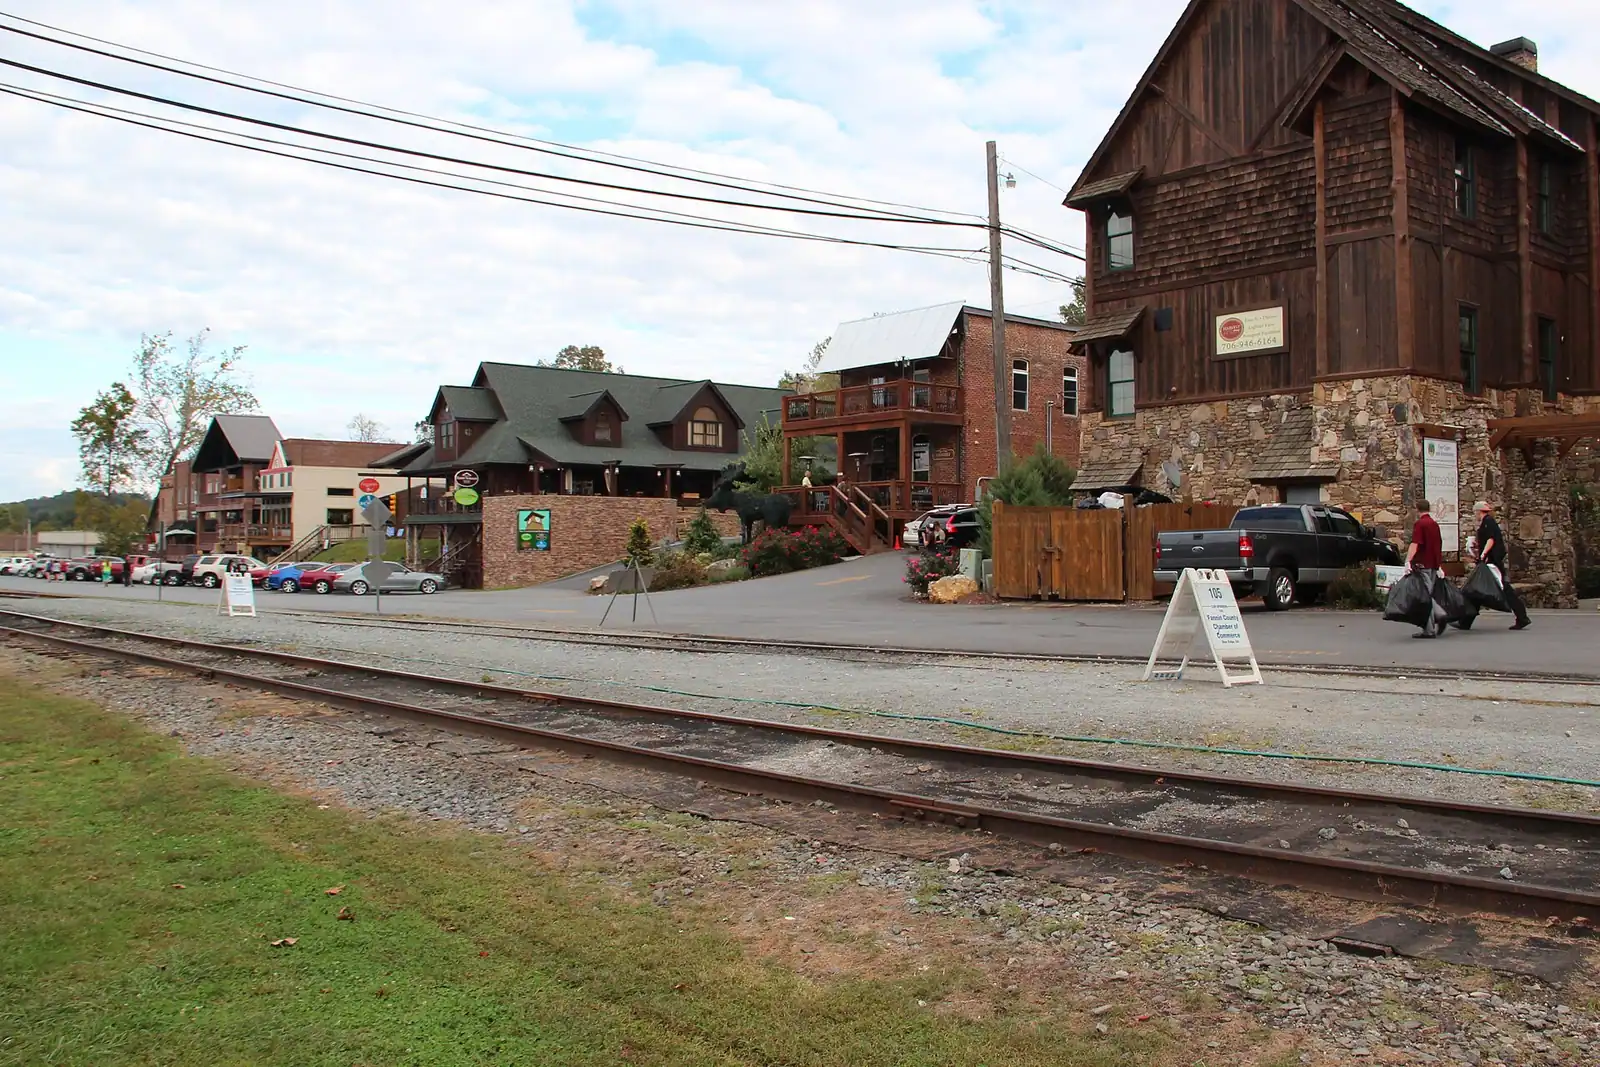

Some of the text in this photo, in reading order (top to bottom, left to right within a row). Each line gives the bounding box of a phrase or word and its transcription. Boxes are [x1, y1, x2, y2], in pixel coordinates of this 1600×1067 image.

[1221, 337, 1276, 350] 706-946-6164
[1208, 587, 1223, 599] 105
[1223, 614, 1239, 622] County
